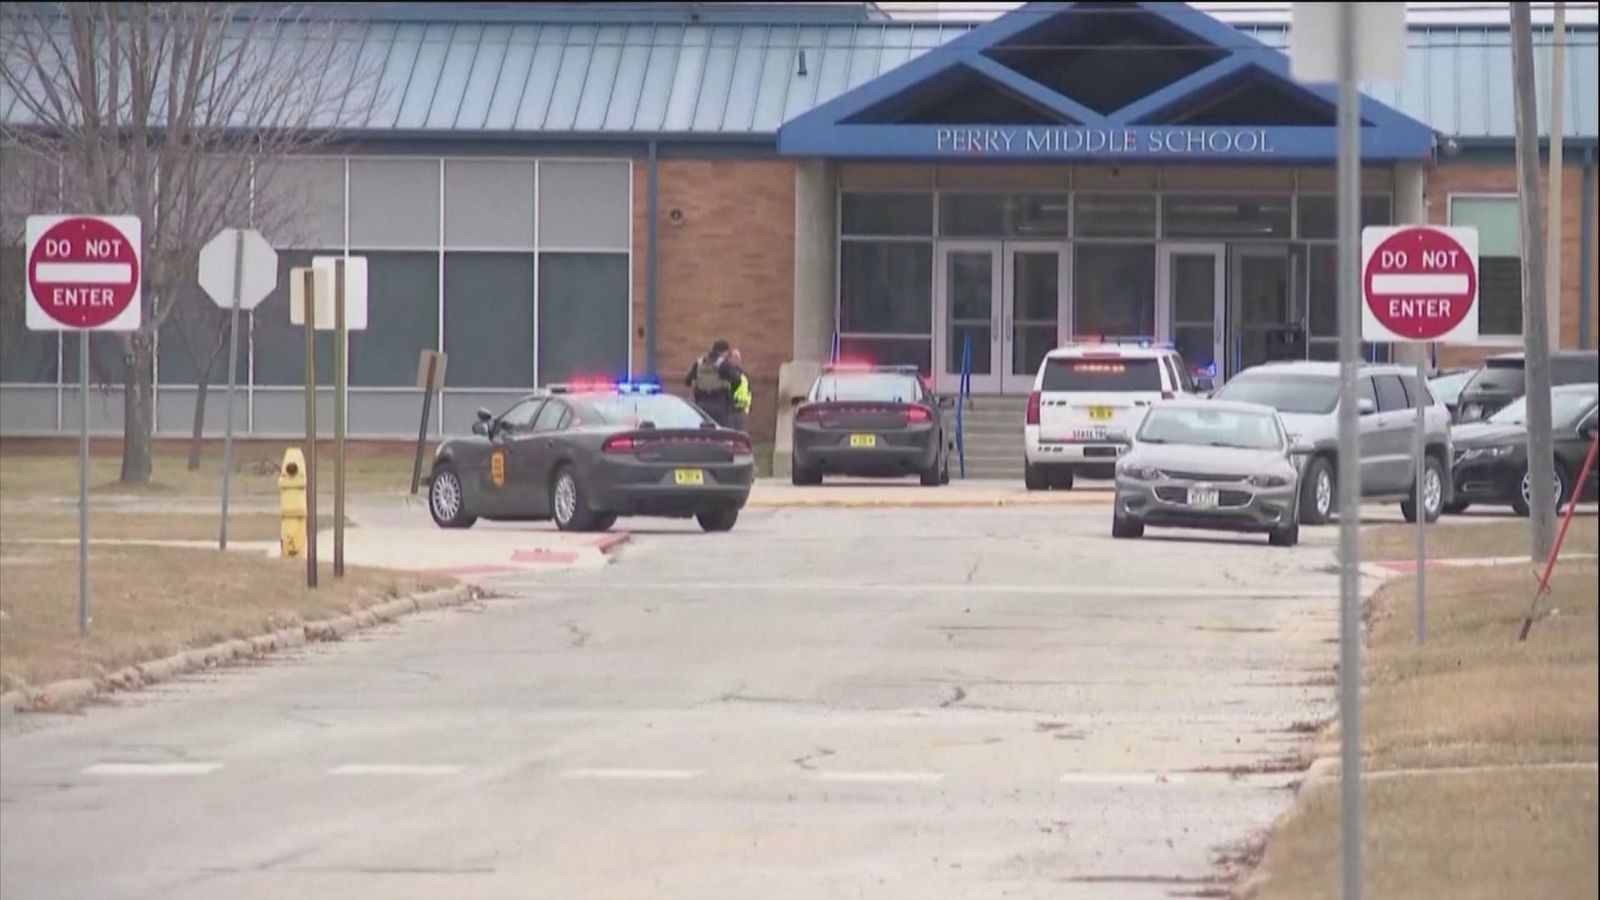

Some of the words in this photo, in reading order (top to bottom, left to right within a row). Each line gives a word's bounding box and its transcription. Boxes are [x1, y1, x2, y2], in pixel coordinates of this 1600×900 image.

[936, 129, 1016, 152] PERRY
[1026, 129, 1137, 152] MIDDLE
[1149, 129, 1274, 153] SCHOOL
[45, 239, 71, 257] DO
[85, 239, 122, 257] NOT
[1381, 250, 1408, 269] DO
[1422, 250, 1459, 269] NOT
[53, 288, 114, 307] ENTER
[1389, 299, 1451, 318] ENTER
